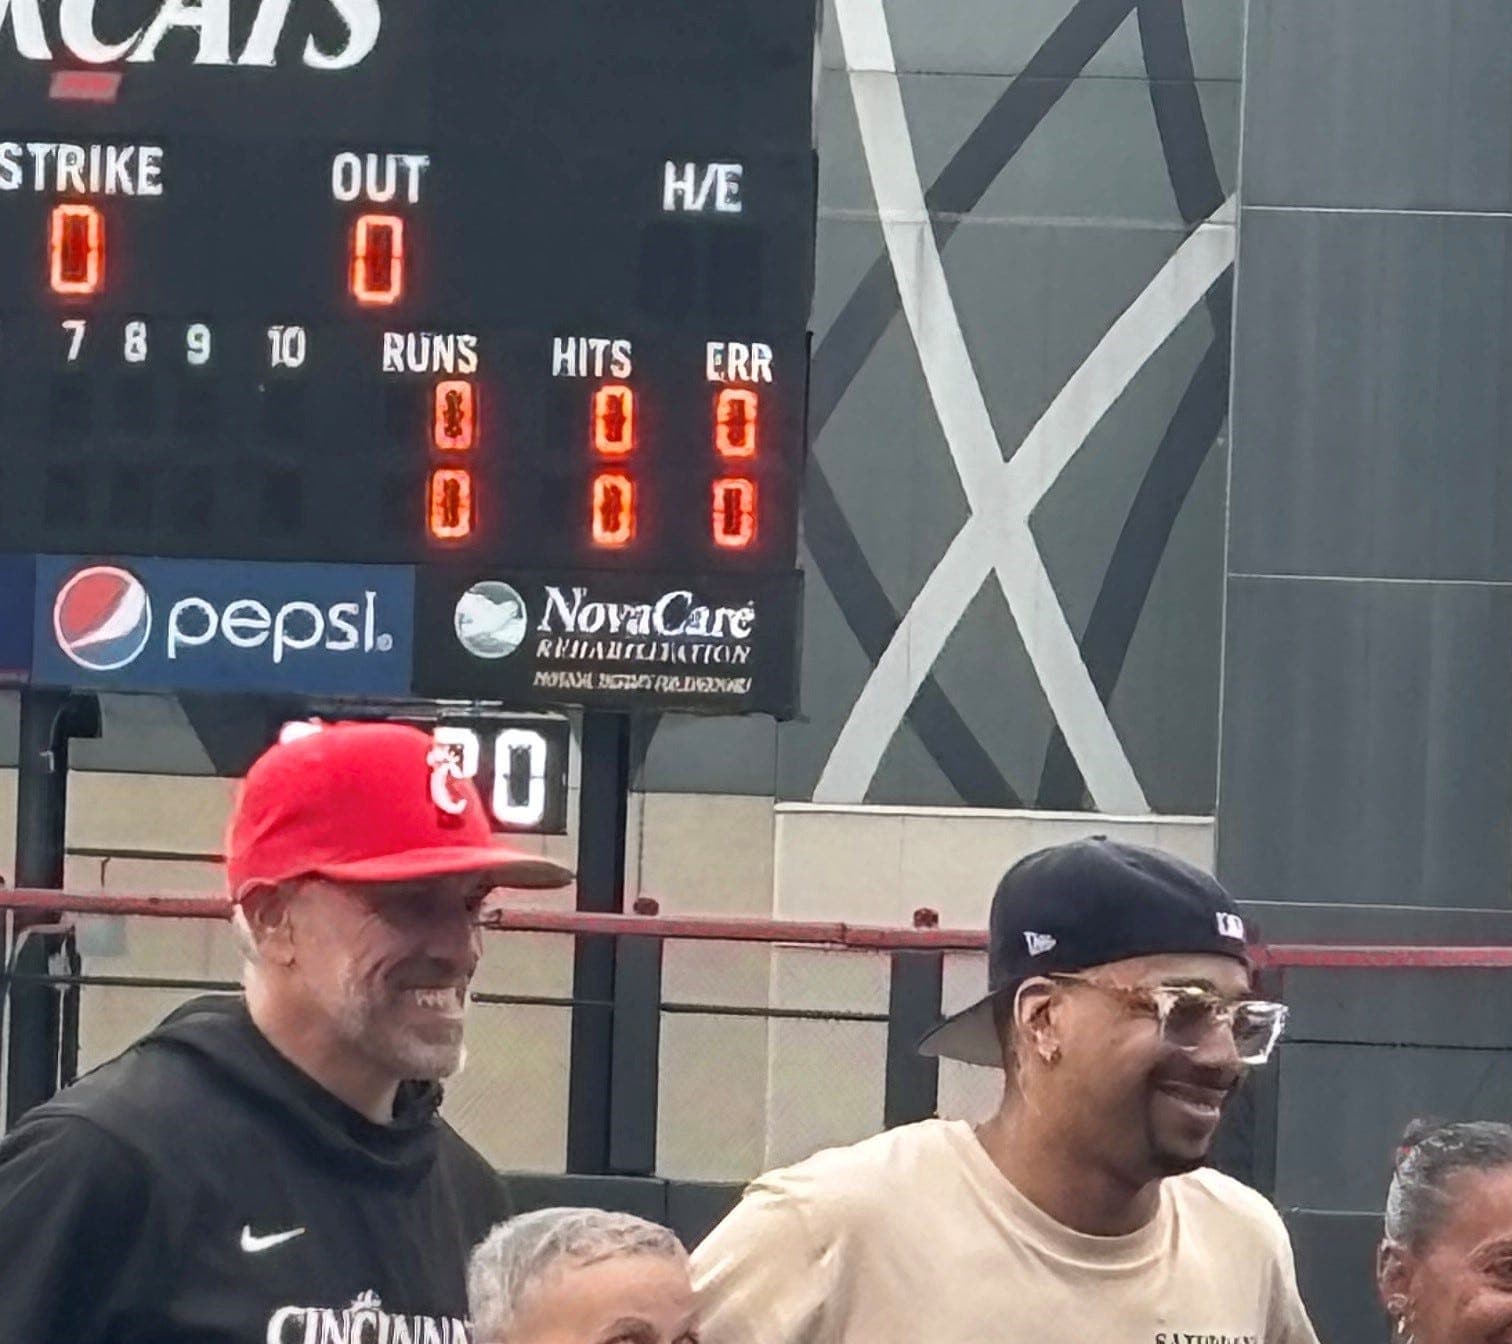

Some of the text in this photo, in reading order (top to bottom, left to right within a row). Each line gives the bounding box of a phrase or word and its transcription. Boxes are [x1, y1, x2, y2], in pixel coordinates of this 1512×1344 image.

[0, 0, 381, 70] CATS
[0, 142, 744, 213] STRIKE OUT H/E
[50, 204, 404, 305] 0 0
[62, 319, 774, 383] 7 8 9 10 RUNS HITS ERR
[434, 379, 759, 457] 0 0 0
[431, 468, 755, 548] 0 0 0
[167, 590, 378, 664] pepsi
[537, 585, 755, 639] NovaCare
